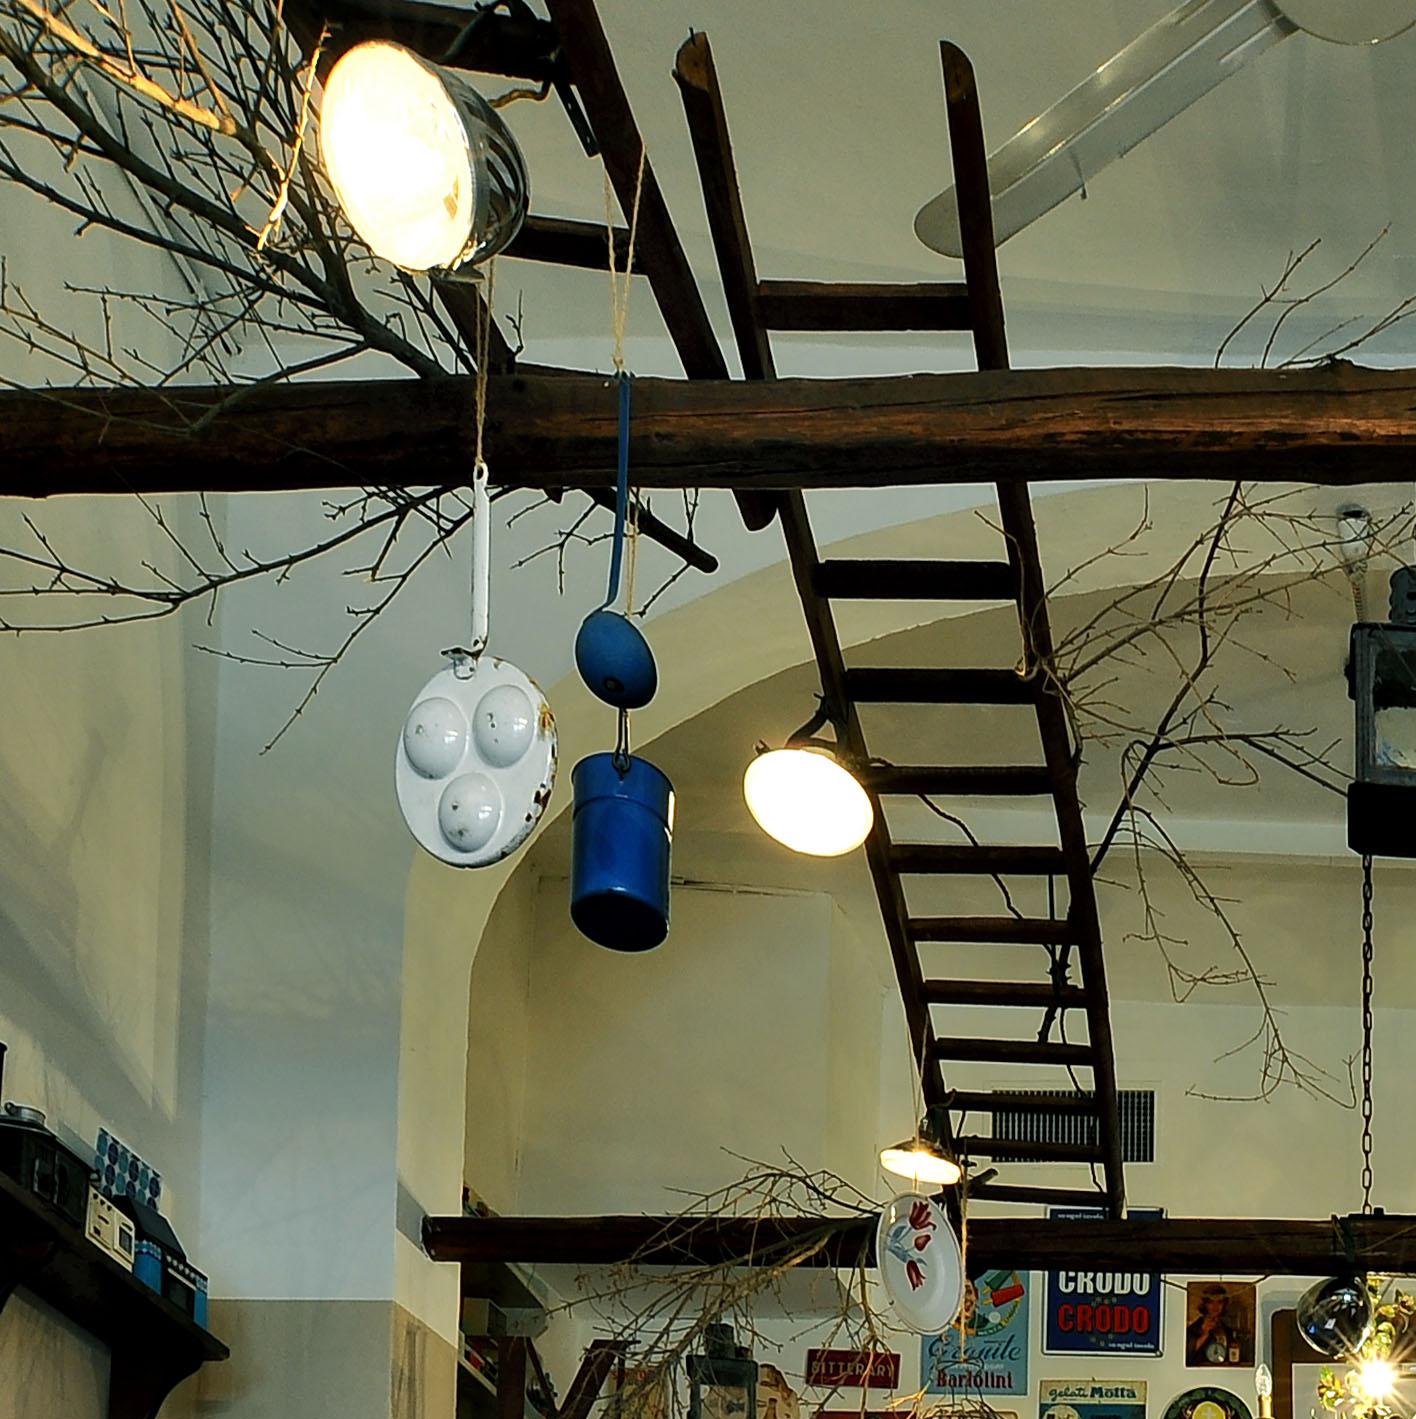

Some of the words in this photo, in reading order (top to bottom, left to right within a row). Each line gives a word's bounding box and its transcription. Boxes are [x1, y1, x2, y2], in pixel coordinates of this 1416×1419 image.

[1057, 1304, 1149, 1333] CRODO
[1049, 1387, 1088, 1401] gelati
[1090, 1386, 1137, 1399] Motta
